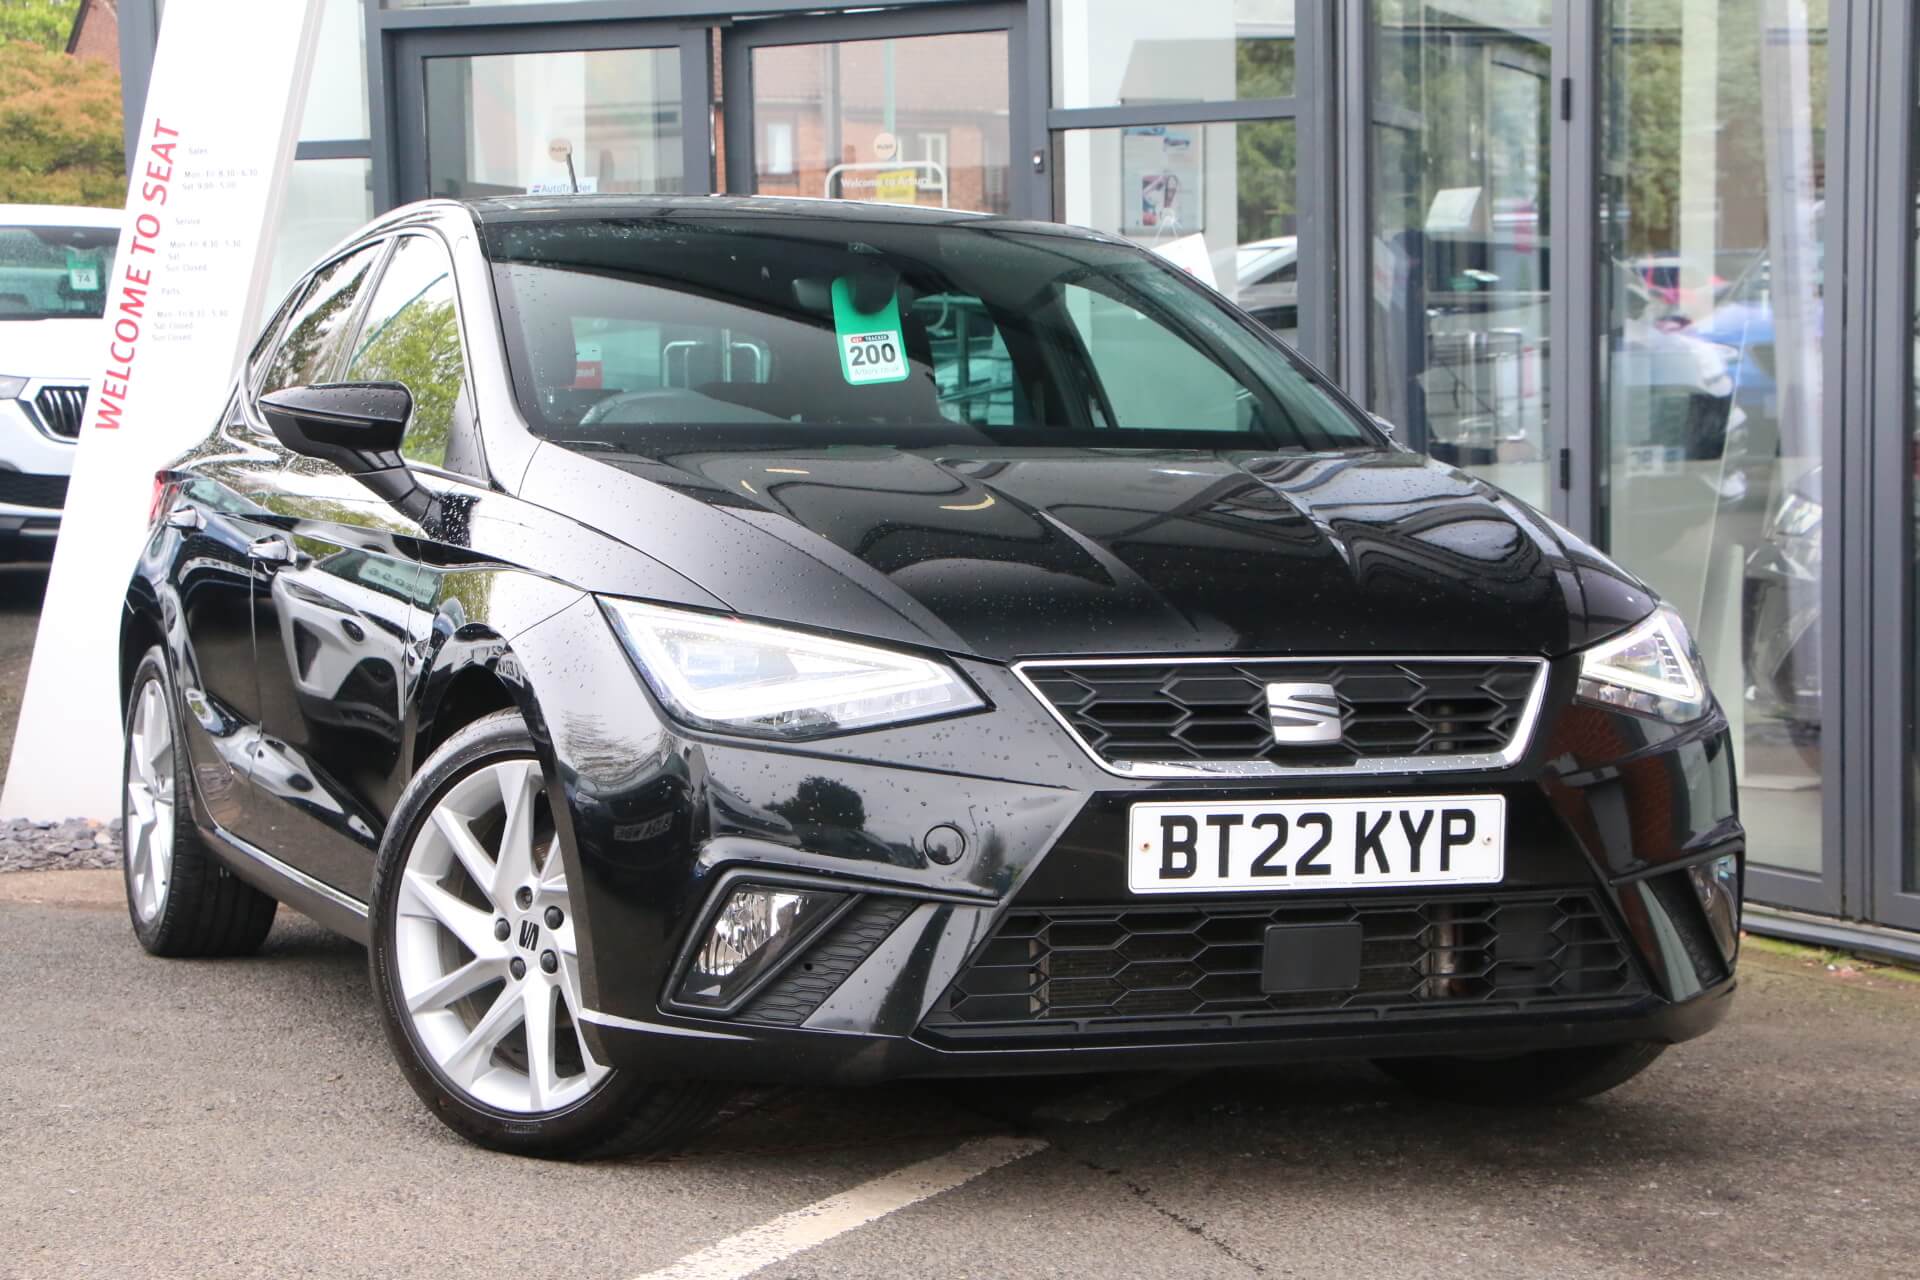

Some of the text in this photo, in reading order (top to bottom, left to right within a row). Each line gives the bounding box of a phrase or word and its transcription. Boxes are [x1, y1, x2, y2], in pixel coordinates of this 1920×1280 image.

[188, 147, 208, 155] Sales
[542, 184, 592, 193] AutoTrder
[175, 217, 200, 225] Service
[182, 264, 207, 272] Closed
[95, 118, 179, 430] WELCOME TO SEAT
[161, 287, 180, 295] Parts
[849, 343, 896, 366] 200
[1159, 808, 1476, 879] BT22 KYP
